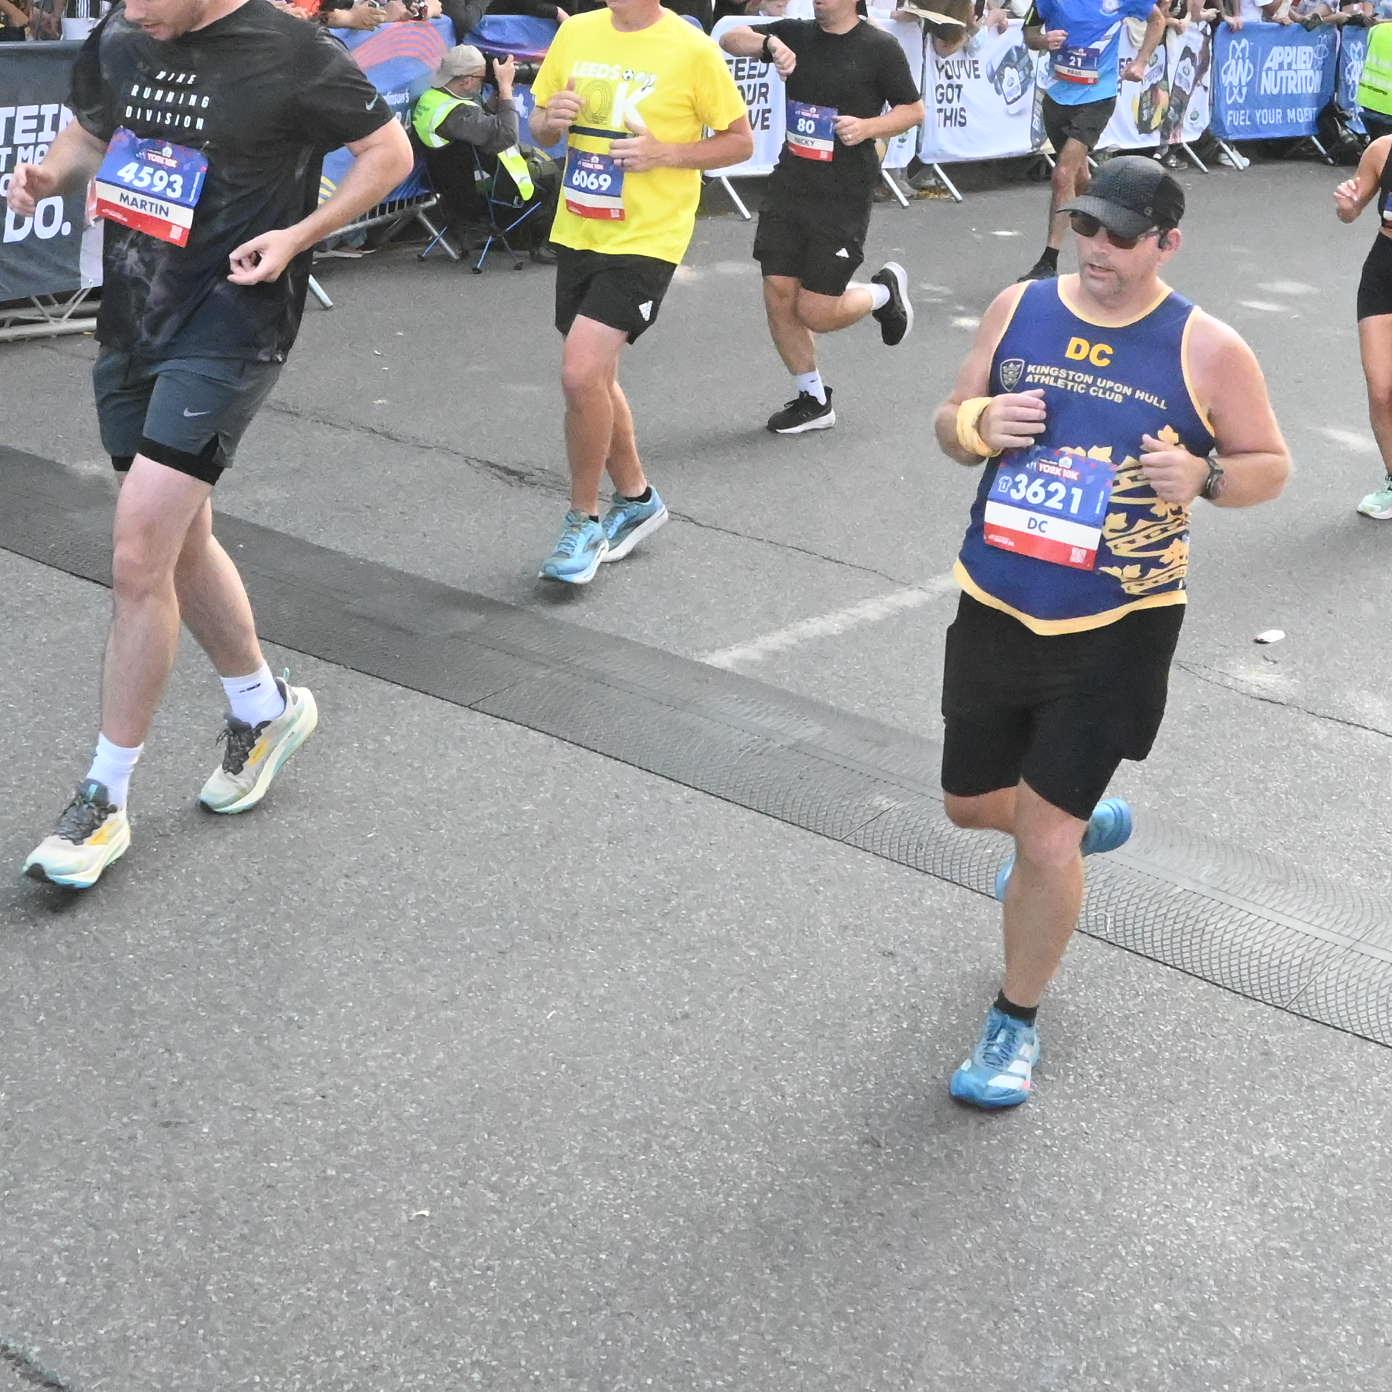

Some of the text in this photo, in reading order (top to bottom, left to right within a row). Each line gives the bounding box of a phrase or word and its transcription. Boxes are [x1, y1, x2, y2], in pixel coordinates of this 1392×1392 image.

[935, 59, 981, 80] YOU'VE
[1069, 55, 1083, 68] 21
[1263, 45, 1315, 70] APPLIED
[130, 84, 210, 108] RUNNING
[737, 83, 769, 106] UR
[935, 83, 964, 104] GOT
[125, 105, 205, 131] DIVISION
[796, 117, 816, 134] 80
[936, 107, 967, 128] THIS
[1226, 109, 1251, 127] FUEL
[1255, 108, 1283, 125] YOUR
[116, 161, 184, 199] 4593
[572, 168, 612, 191] 6069
[119, 192, 170, 218] MARTIN
[3, 195, 71, 244] DO.
[1064, 336, 1115, 367] DC
[1024, 374, 1124, 404] ATHLETIC CLUB
[1026, 364, 1169, 411] KINGSTON UPON HULL
[1009, 473, 1083, 515] 3621
[1027, 516, 1049, 534] DC
